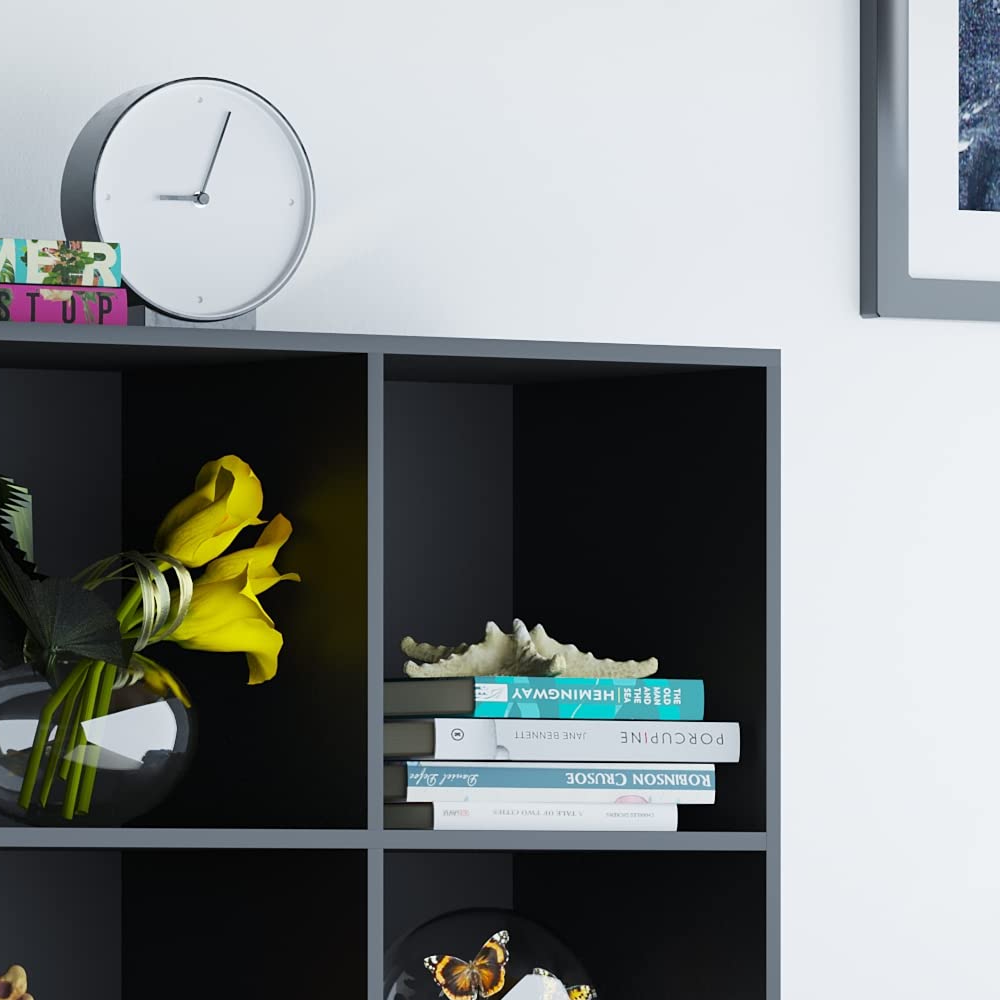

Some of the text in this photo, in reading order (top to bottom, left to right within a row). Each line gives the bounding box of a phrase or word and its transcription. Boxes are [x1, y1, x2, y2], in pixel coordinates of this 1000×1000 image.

[512, 687, 615, 702] HEMINGWAY
[623, 687, 631, 703] SEA
[634, 687, 642, 704] THE
[643, 686, 651, 705] AND
[653, 686, 662, 706] MAN
[663, 687, 671, 705] OLD
[514, 731, 587, 741] JANE BENNETT
[619, 731, 725, 746] PORCUPINE
[409, 772, 480, 788] Daniel Defoe
[566, 771, 711, 787] ROBINSON CRUSOE
